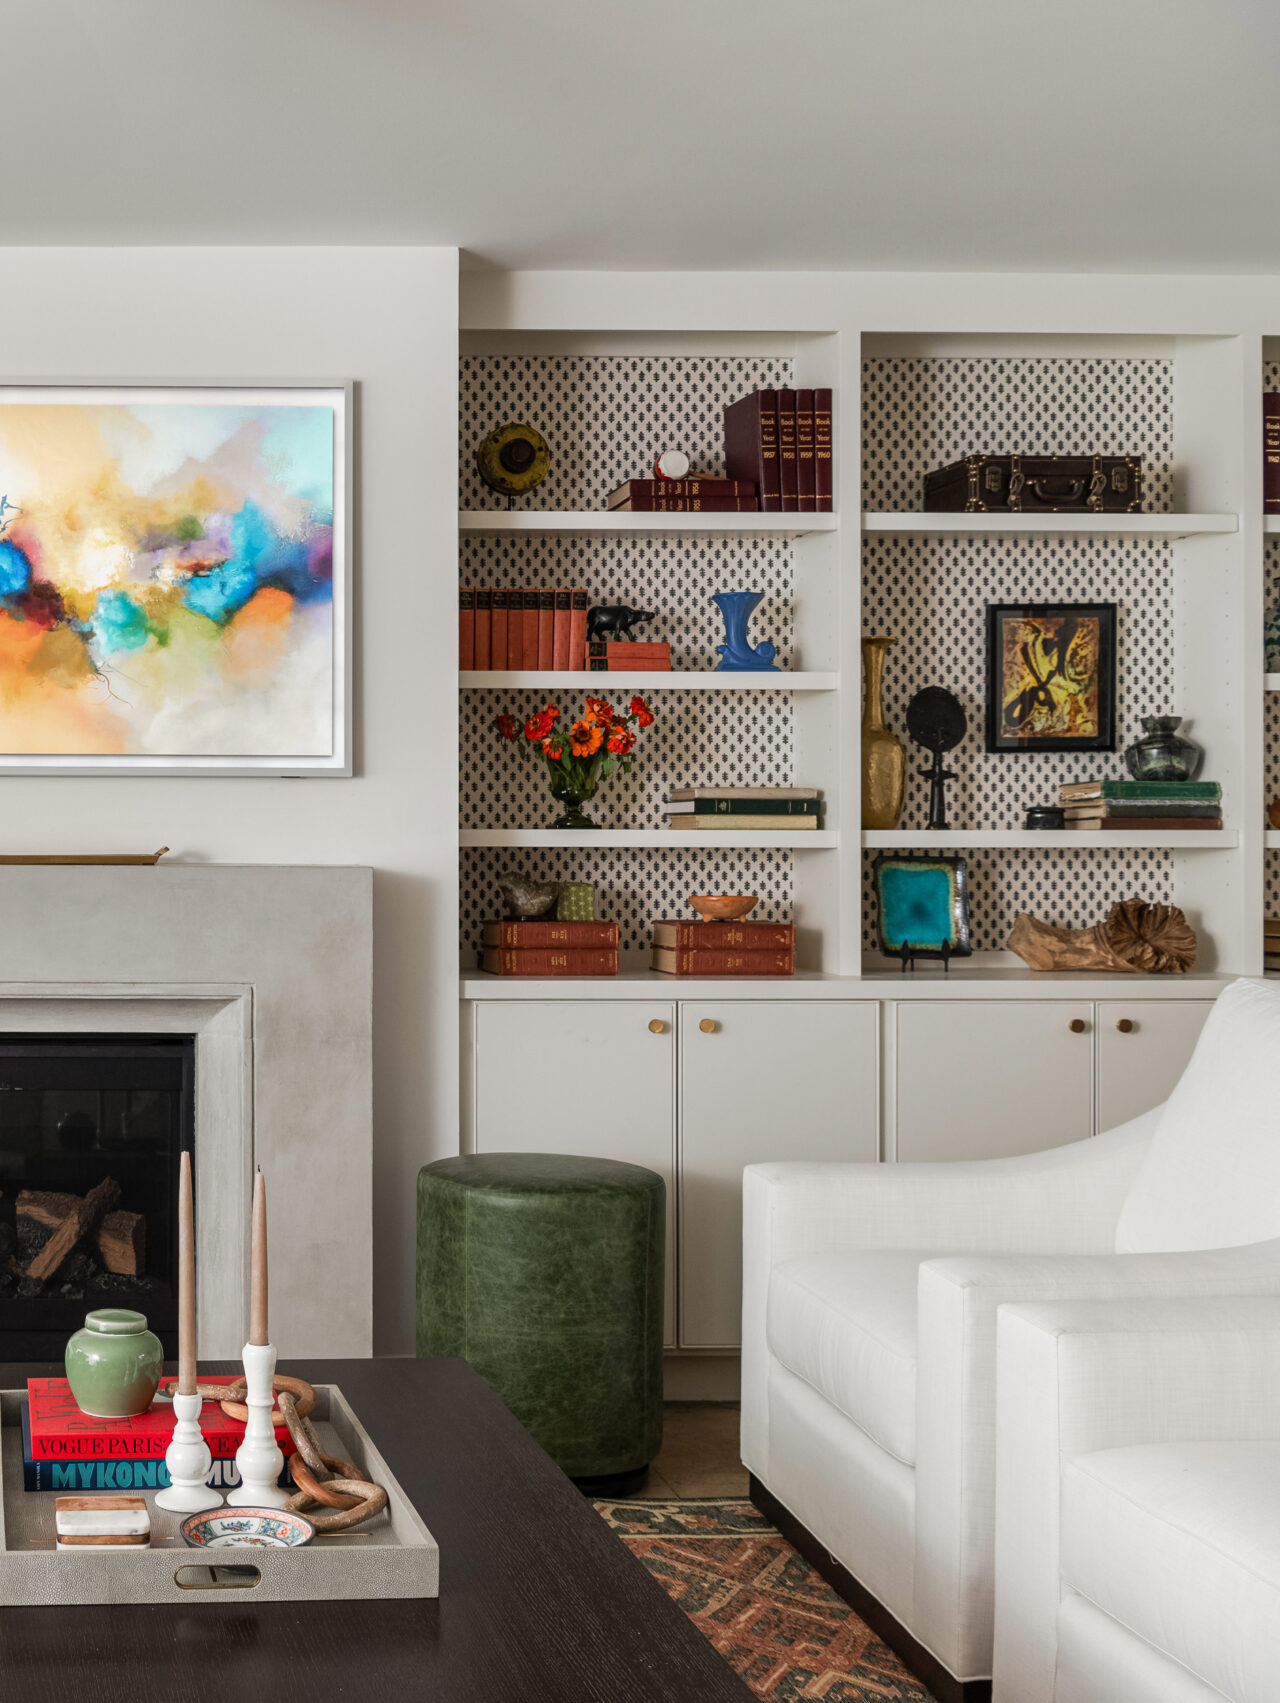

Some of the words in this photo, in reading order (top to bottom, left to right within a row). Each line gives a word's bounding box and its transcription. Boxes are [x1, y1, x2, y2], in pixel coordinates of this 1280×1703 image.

[817, 451, 831, 459] 1960
[39, 1438, 104, 1455] VOGUE
[108, 1437, 166, 1454] PARIS:
[203, 1437, 242, 1453] YEA
[52, 1461, 172, 1489] MYKONO
